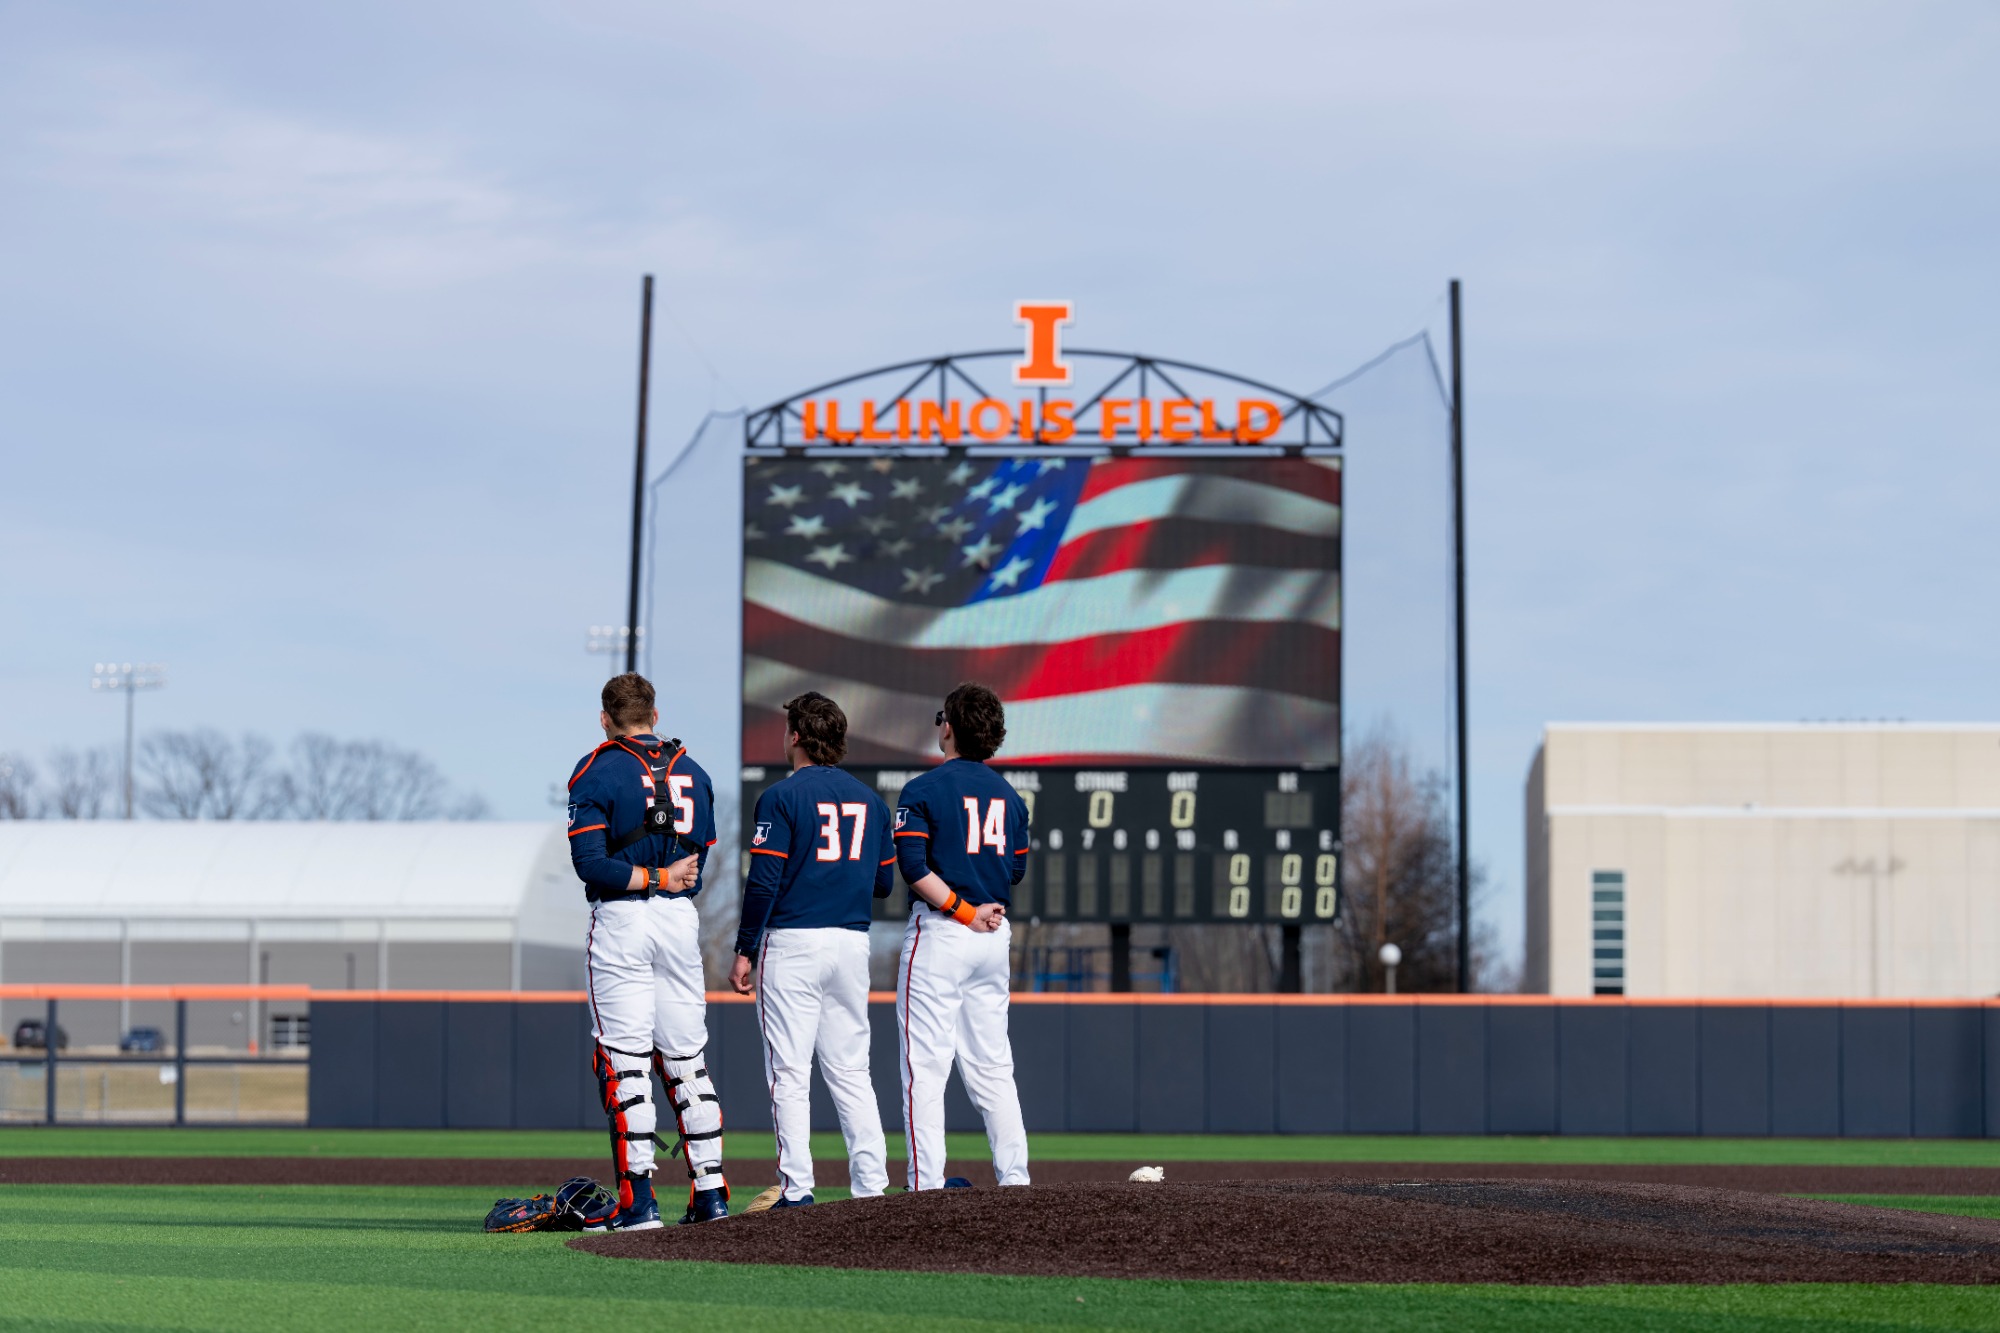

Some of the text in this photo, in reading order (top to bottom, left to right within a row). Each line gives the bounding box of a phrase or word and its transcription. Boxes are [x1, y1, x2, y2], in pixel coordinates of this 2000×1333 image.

[1014, 301, 1073, 385] I
[802, 398, 1283, 443] ILLINOIS FIELD
[963, 796, 1006, 856] 14
[1089, 790, 1196, 828] 0 0
[816, 802, 867, 862] 37
[1081, 829, 1096, 850] 7
[1318, 829, 1333, 850] E
[1229, 853, 1336, 885] 0 0 0
[1229, 886, 1336, 918] 0 0 0
